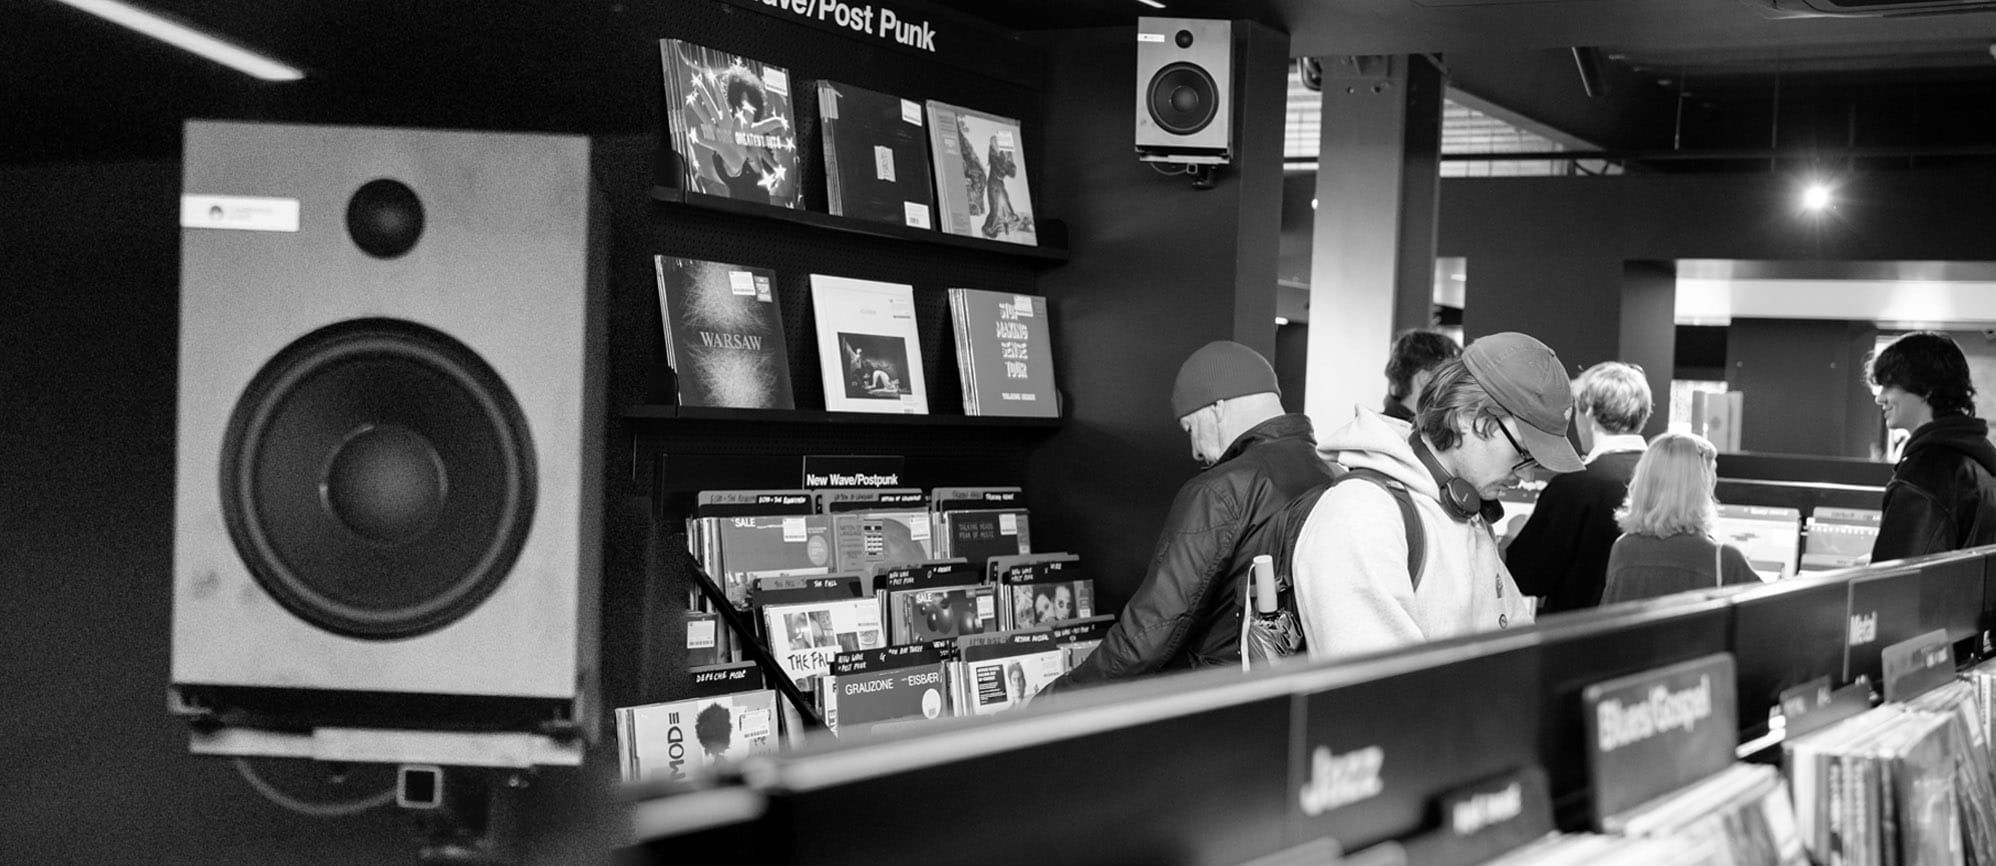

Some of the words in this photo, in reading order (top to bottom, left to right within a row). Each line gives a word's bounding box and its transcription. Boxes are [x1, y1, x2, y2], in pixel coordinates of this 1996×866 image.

[879, 8, 936, 52] Punk
[700, 331, 762, 351] WARSAW
[807, 474, 827, 486] New
[829, 473, 898, 487] Wave/Postpunk
[735, 518, 756, 528] SALE
[916, 593, 932, 603] SALE
[787, 654, 810, 671] THE
[811, 651, 836, 670] FAL
[696, 670, 727, 683] DEPECHE
[729, 669, 747, 680] MODE
[845, 678, 894, 696] GRAUZONE
[1298, 744, 1386, 817] Jazz
